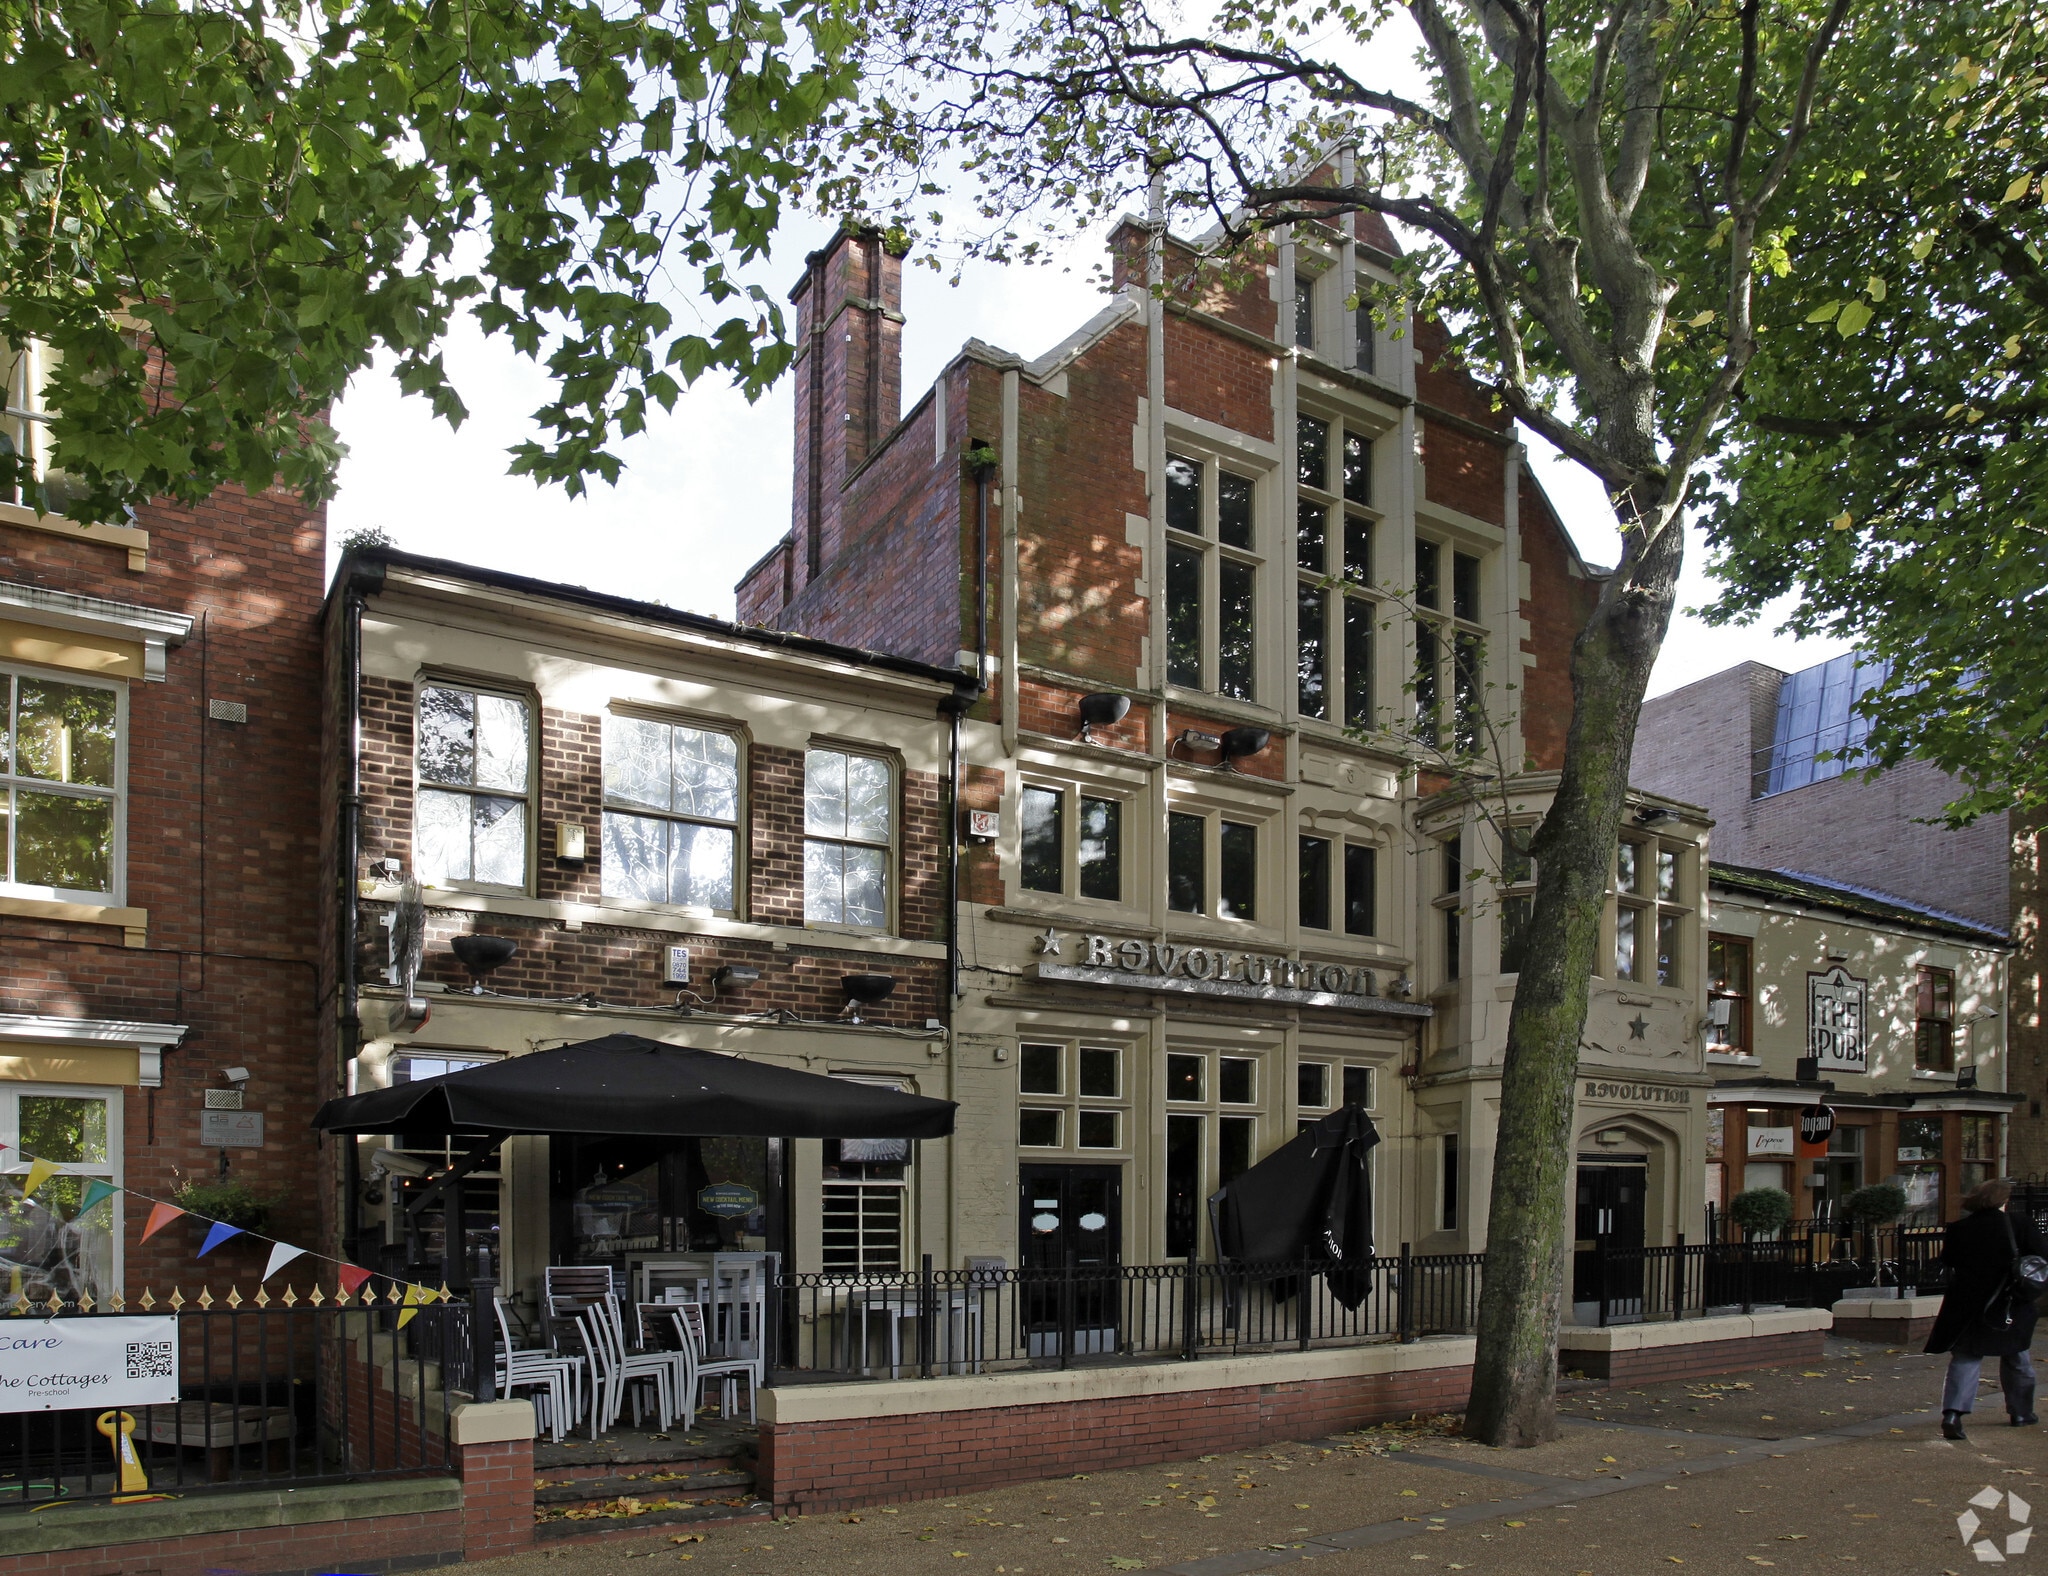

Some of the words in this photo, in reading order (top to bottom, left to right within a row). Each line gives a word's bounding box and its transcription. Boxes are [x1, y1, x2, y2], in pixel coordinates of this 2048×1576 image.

[672, 949, 687, 958] TES
[1815, 994, 1858, 1029] THE
[1817, 1028, 1858, 1061] PUB
[27, 1373, 112, 1389] Cottages
[28, 1388, 70, 1397] Pre-school
